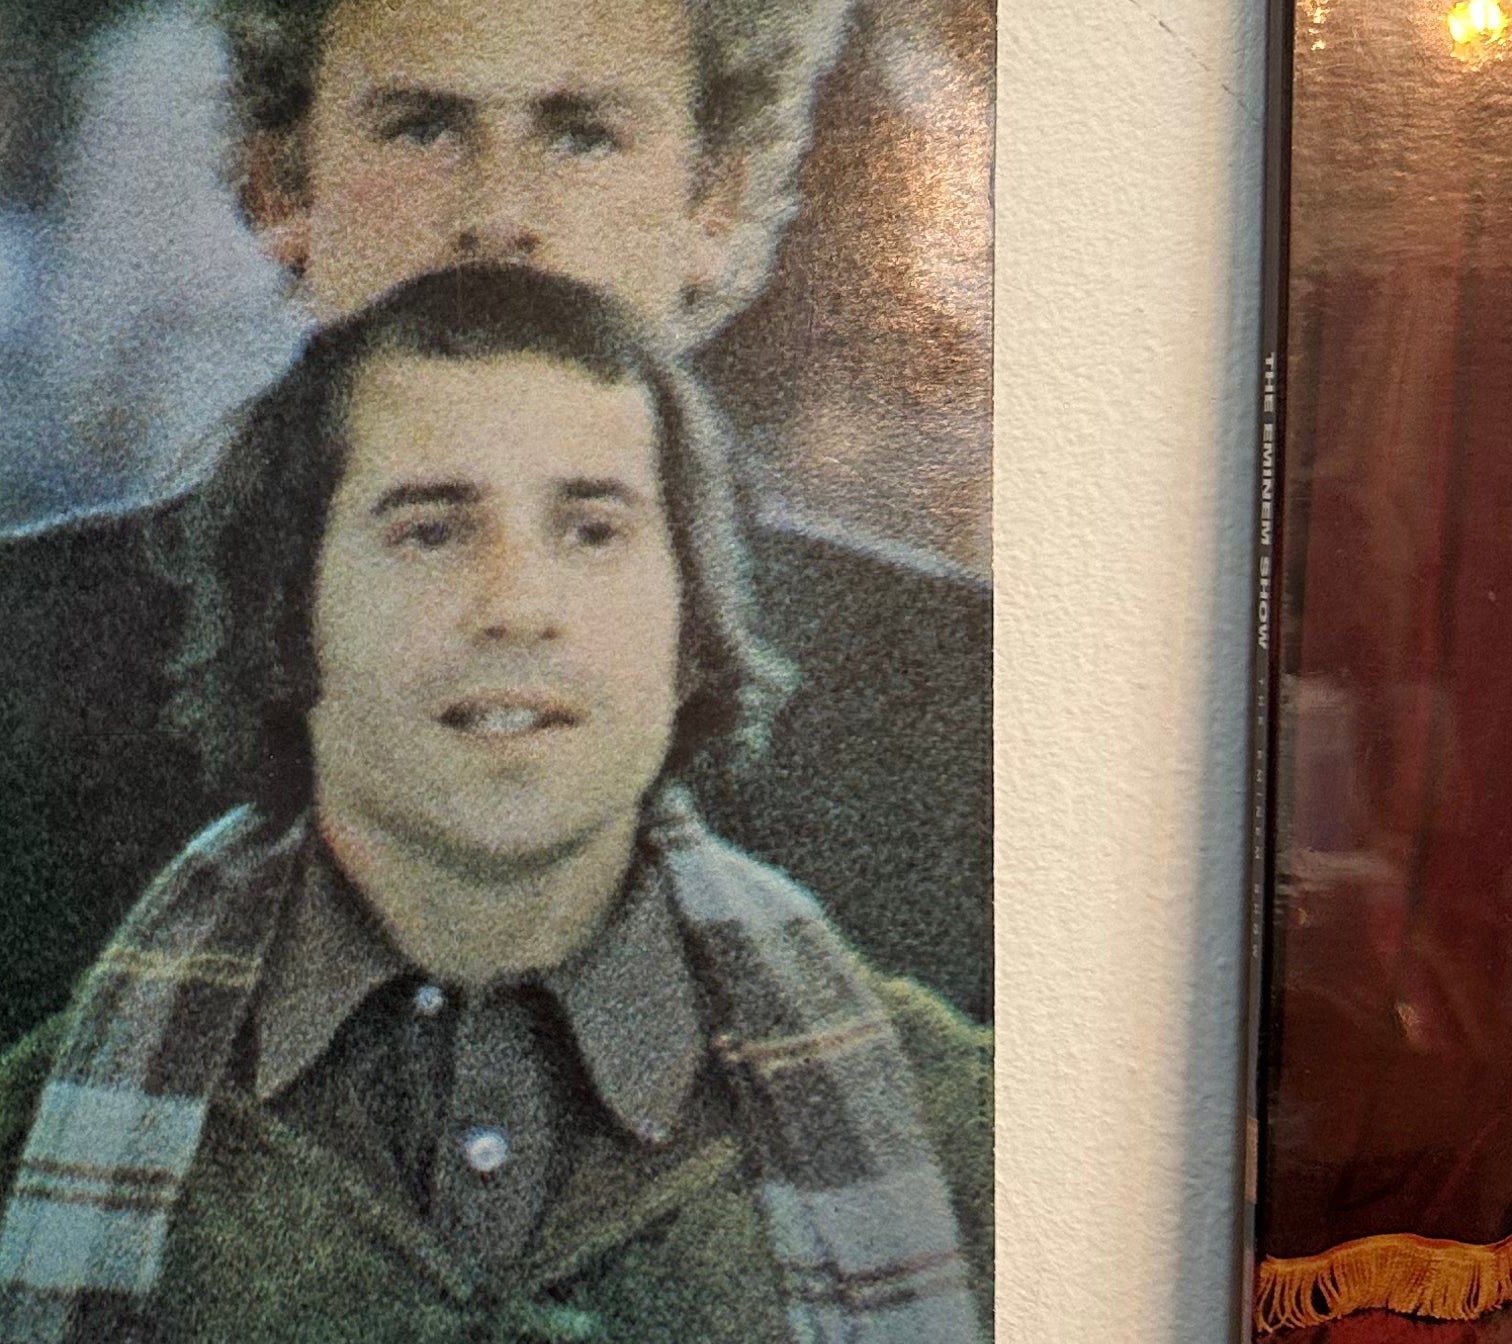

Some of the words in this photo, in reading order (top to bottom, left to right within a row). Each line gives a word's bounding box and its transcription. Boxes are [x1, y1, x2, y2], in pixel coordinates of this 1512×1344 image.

[1263, 352, 1276, 413] THE
[1260, 422, 1274, 546] EMINEM
[1257, 555, 1272, 650] SHOW
